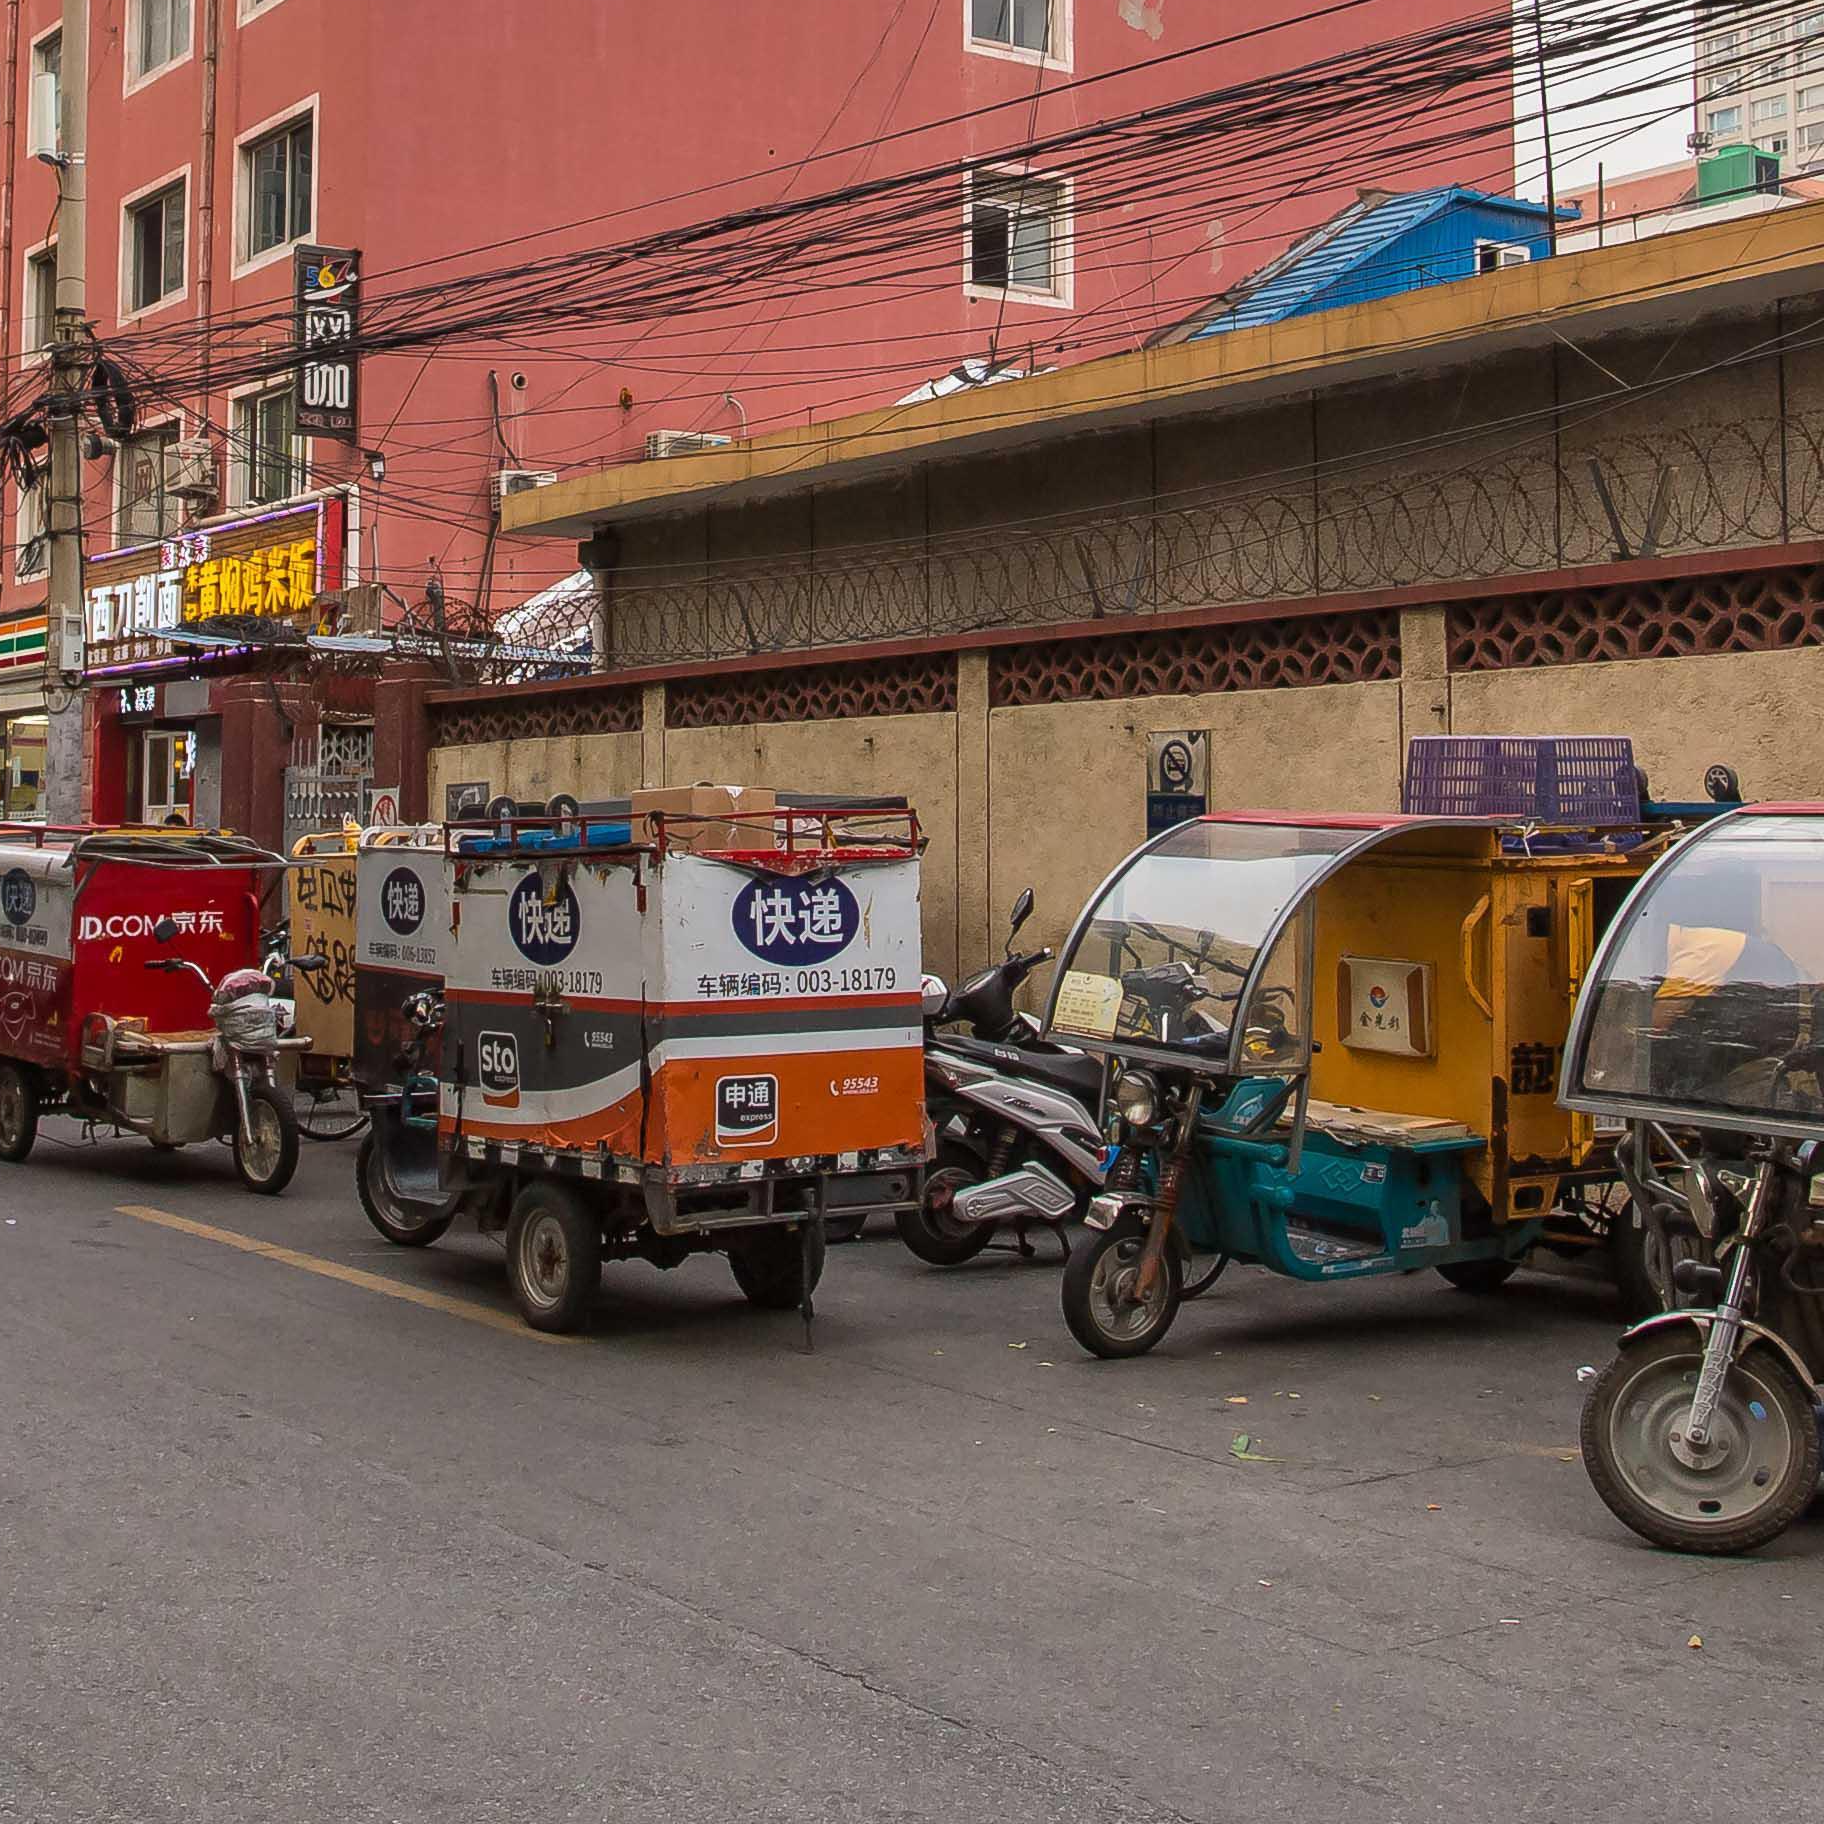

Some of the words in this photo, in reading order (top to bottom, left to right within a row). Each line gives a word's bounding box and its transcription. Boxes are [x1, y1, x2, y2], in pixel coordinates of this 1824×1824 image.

[198, 540, 315, 622] 黄焖鸡米饭
[85, 570, 183, 644] 西刀削面
[387, 881, 419, 921] 快递
[518, 891, 572, 945] 快递
[750, 887, 844, 947] 快递
[27, 961, 58, 992] 京东
[481, 1040, 515, 1074] sto
[725, 1082, 770, 1109] 申通
[842, 1076, 879, 1090] 95543
[739, 1112, 774, 1122] express
